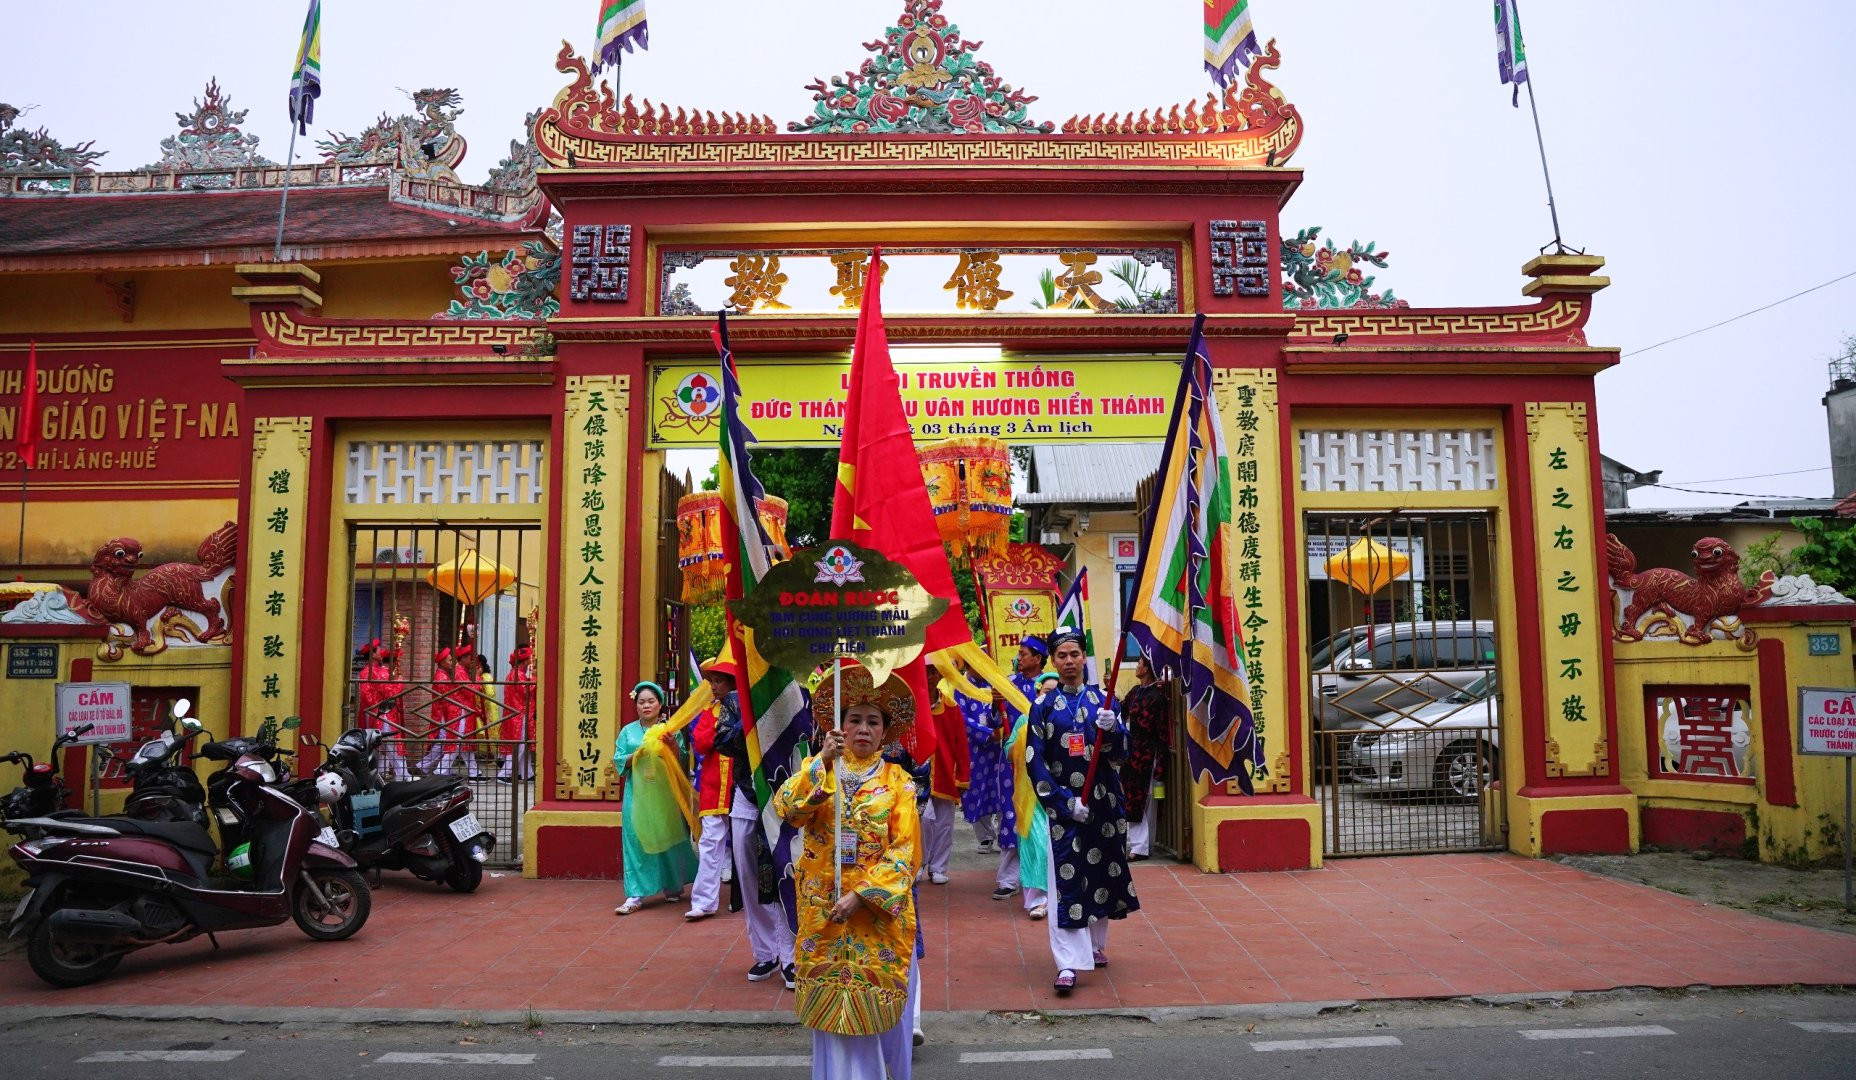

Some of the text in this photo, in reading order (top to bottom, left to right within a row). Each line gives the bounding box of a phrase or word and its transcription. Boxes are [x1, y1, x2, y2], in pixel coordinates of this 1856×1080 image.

[917, 366, 996, 389] TRUYỀN
[1004, 365, 1075, 388] THỐNG
[751, 399, 792, 418] ĐỨC
[799, 398, 847, 417] THÁN
[926, 397, 964, 417] VÂN
[973, 398, 1040, 416] HƯƠNG
[1048, 392, 1093, 415] HIỂN
[1100, 395, 1164, 414] THÁNH
[42, 398, 107, 440] GIÁO
[922, 424, 941, 434] 03
[948, 422, 1001, 435] tháng
[1006, 423, 1016, 433] 3
[1022, 419, 1052, 432] Âm
[1059, 422, 1093, 434] lịch
[779, 590, 899, 607] ĐOÀN RƯỚC
[769, 612, 794, 624] TAM
[799, 612, 832, 624] CUNG
[836, 611, 877, 622] VƯƠNG
[1812, 637, 1838, 651] 352
[29, 667, 52, 675] LĂNG
[78, 688, 114, 706] CẤM
[1824, 695, 1856, 715] CẤ
[1808, 715, 1825, 725] CÁC
[1826, 717, 1845, 727] LOẠI
[1826, 740, 1853, 749] THÁNH
